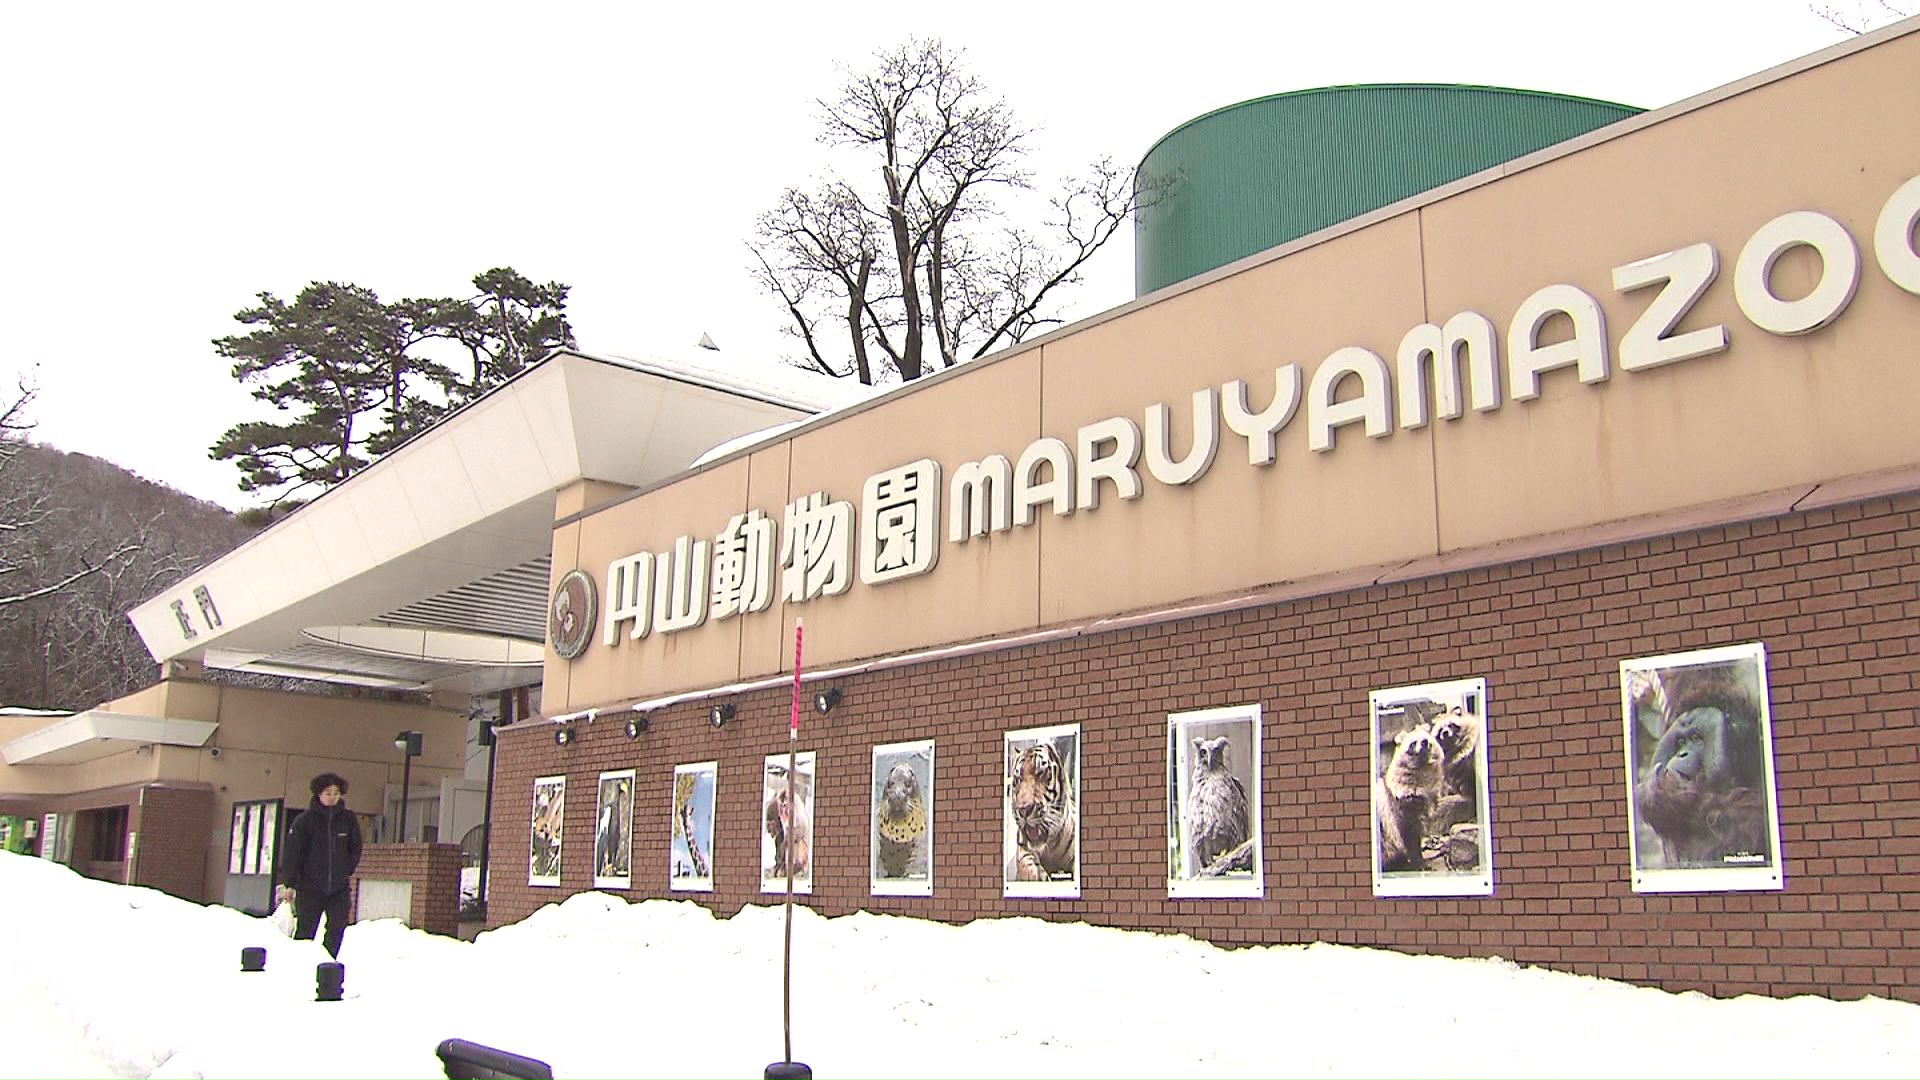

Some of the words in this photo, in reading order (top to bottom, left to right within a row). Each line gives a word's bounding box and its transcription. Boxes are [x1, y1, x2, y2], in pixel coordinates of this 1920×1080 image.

[604, 458, 941, 647] 円山動物園
